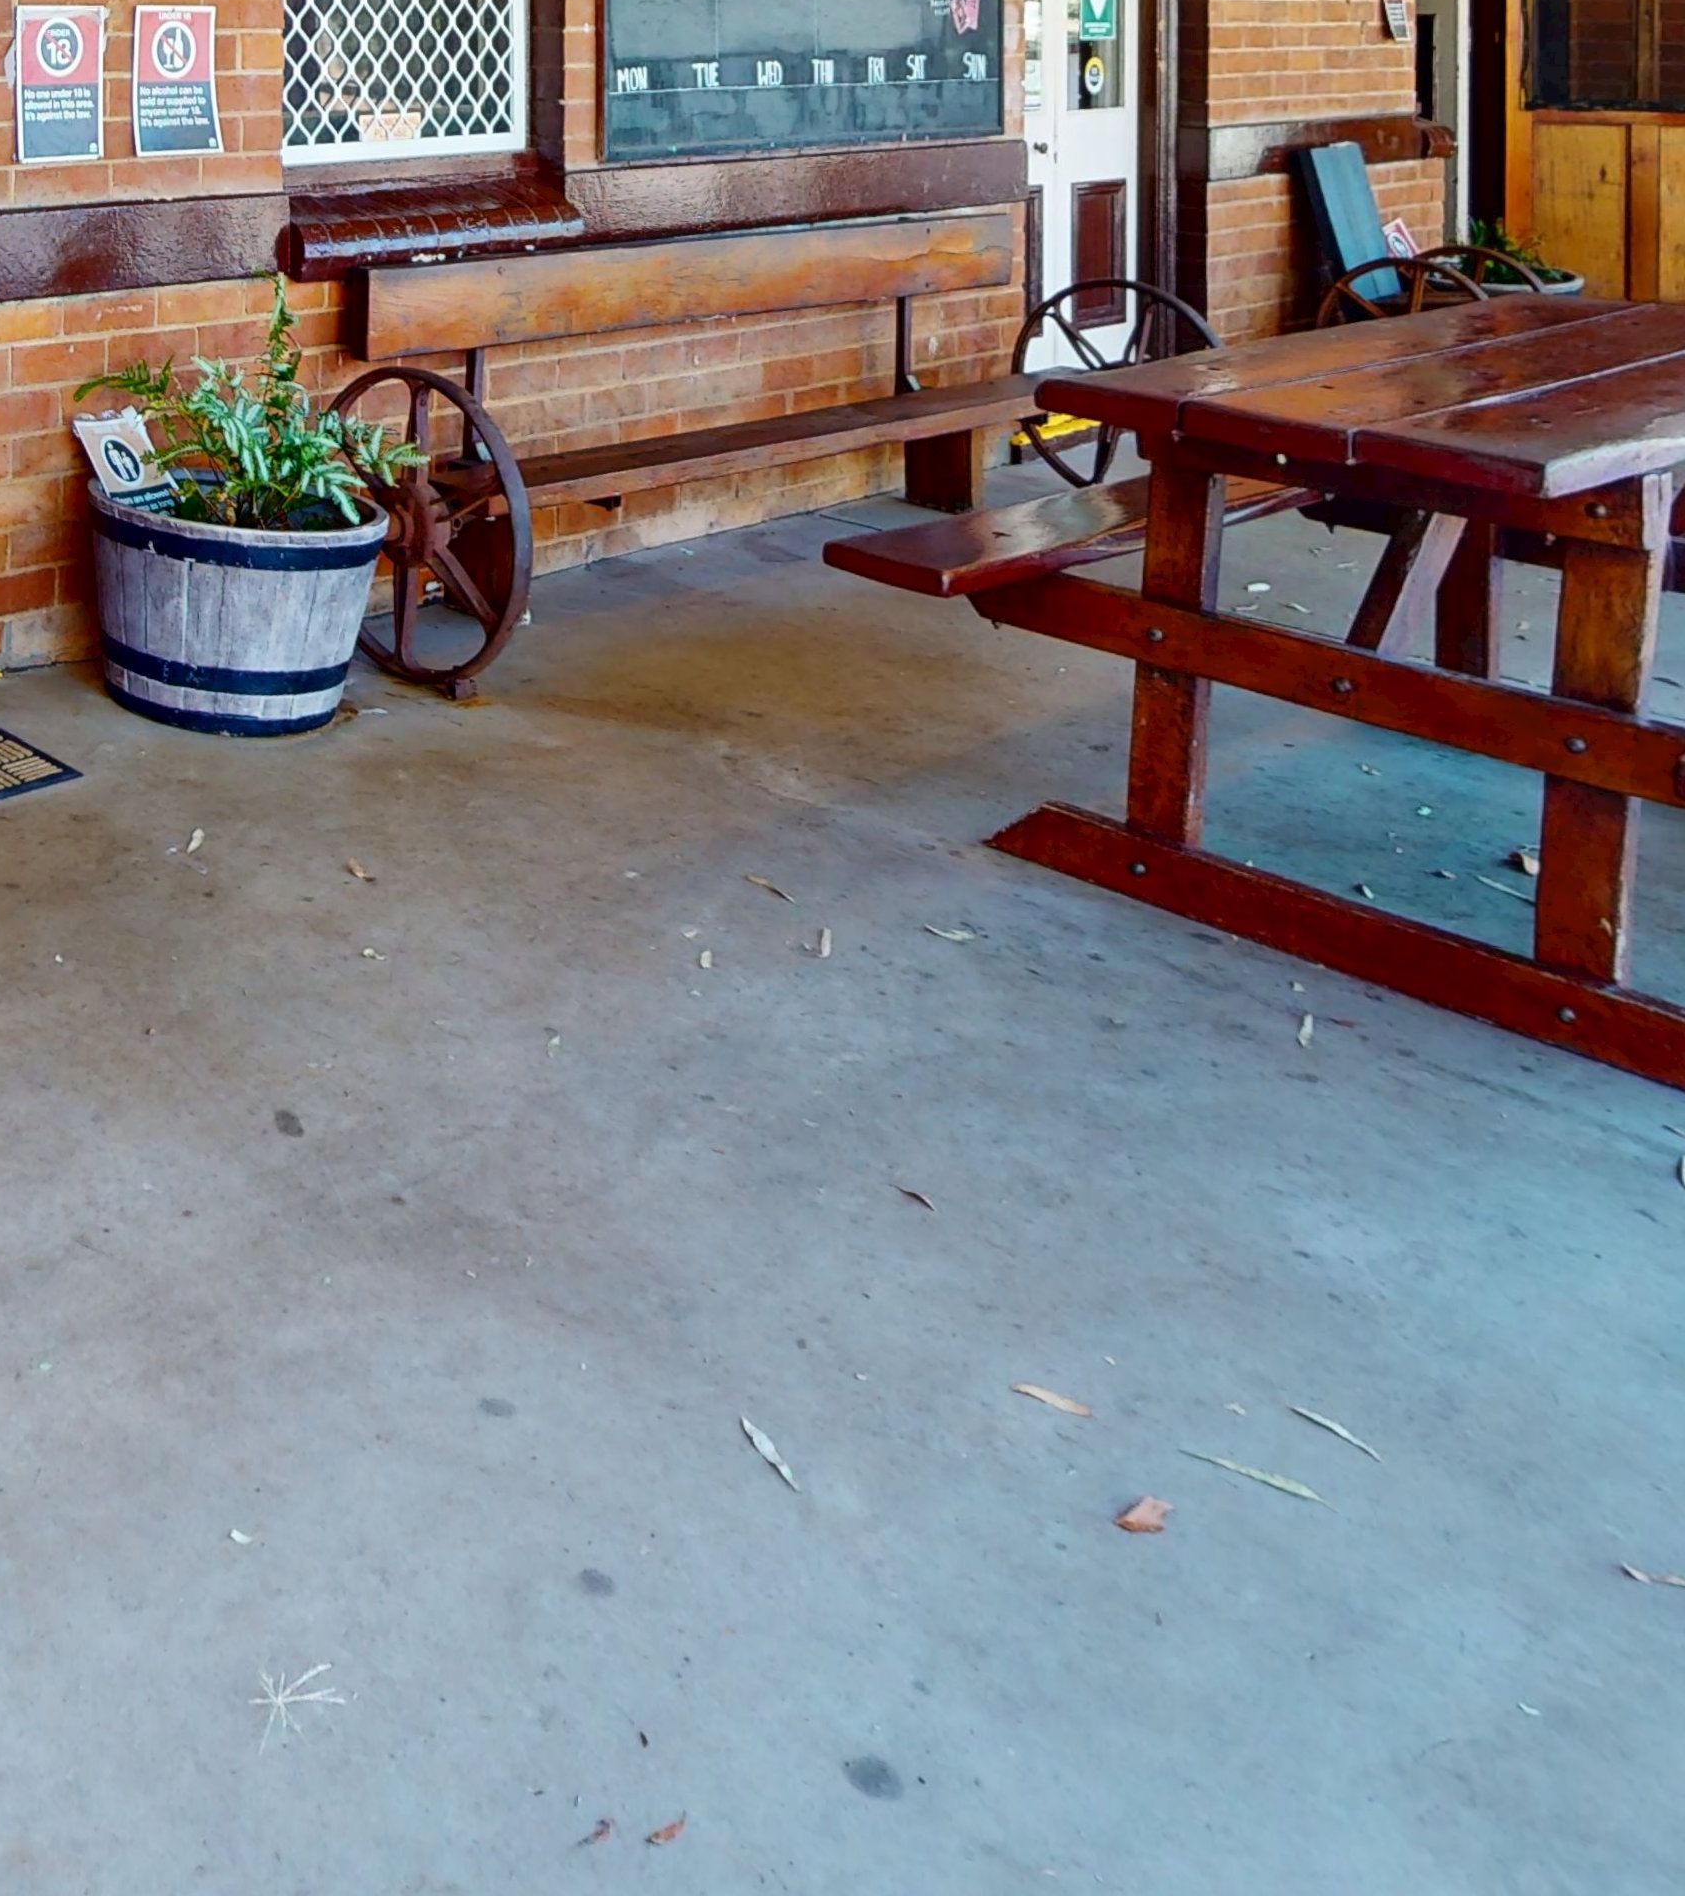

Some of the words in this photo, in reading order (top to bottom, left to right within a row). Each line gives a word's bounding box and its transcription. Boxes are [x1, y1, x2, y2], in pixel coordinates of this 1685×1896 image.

[47, 39, 75, 65] 18
[616, 66, 649, 92] MON
[692, 62, 720, 88] TUE
[756, 60, 784, 86] WED
[811, 59, 835, 84] THU
[867, 57, 885, 84] FRI
[906, 54, 927, 81] SAT
[962, 52, 987, 81] SUN
[24, 88, 35, 100] No
[51, 88, 73, 99] under
[37, 110, 63, 123] against
[63, 109, 75, 120] the
